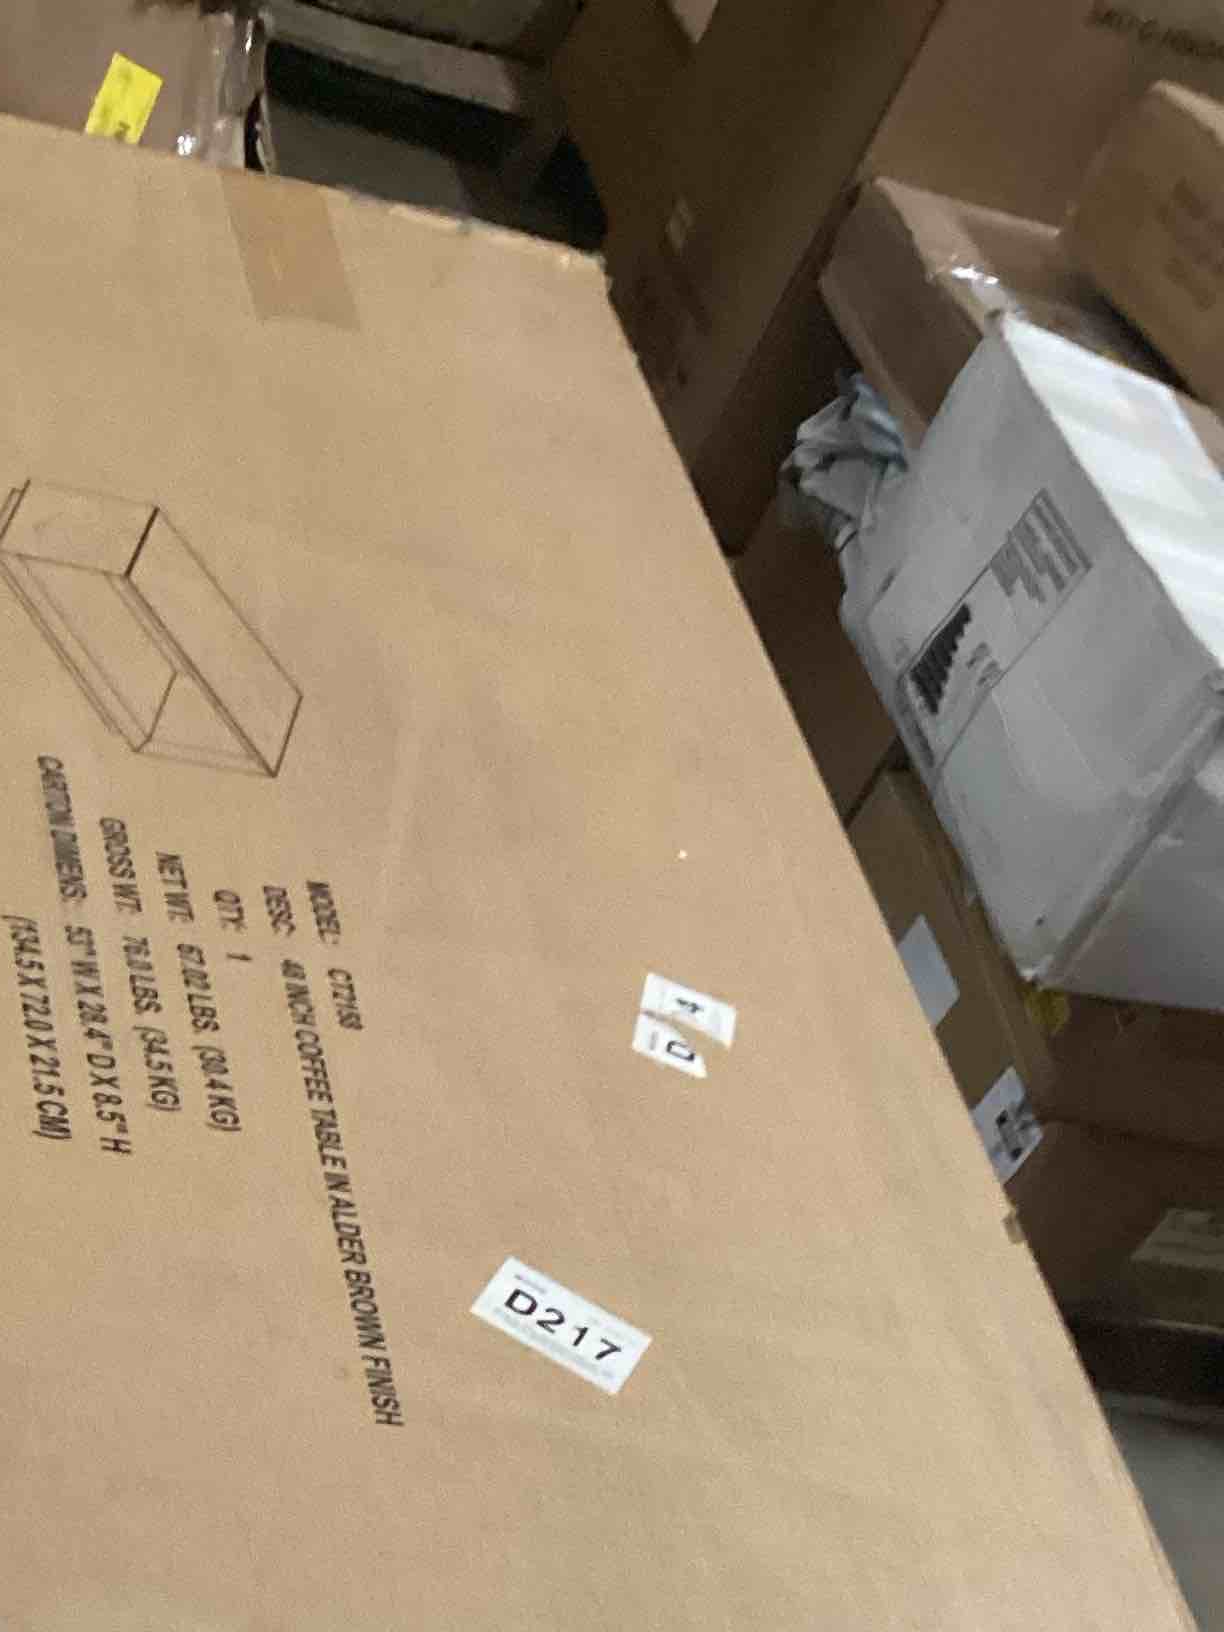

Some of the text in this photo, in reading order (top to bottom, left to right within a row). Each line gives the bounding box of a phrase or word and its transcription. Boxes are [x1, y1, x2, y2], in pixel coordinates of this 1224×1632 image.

[38, 755, 74, 829] CARTON
[17, 972, 46, 990] X
[99, 817, 136, 884] GROSS
[146, 1075, 181, 1113] KG)
[226, 951, 253, 963] 1
[76, 981, 104, 998] X
[156, 851, 186, 891] NET
[206, 1093, 242, 1134] KG)
[285, 980, 318, 1029] INCH
[27, 1034, 58, 1050] X
[87, 1052, 116, 1070] D
[89, 1072, 121, 1088] X
[294, 1028, 334, 1106] COFFEE
[32, 1099, 72, 1142] CM)
[309, 1106, 346, 1170] TABLE
[100, 1136, 132, 1156] H
[323, 1169, 352, 1194] IN
[330, 1195, 367, 1266] ALDER
[344, 1268, 386, 1352] BROWN
[504, 1287, 622, 1361] D217
[361, 1349, 405, 1428] FINISH
